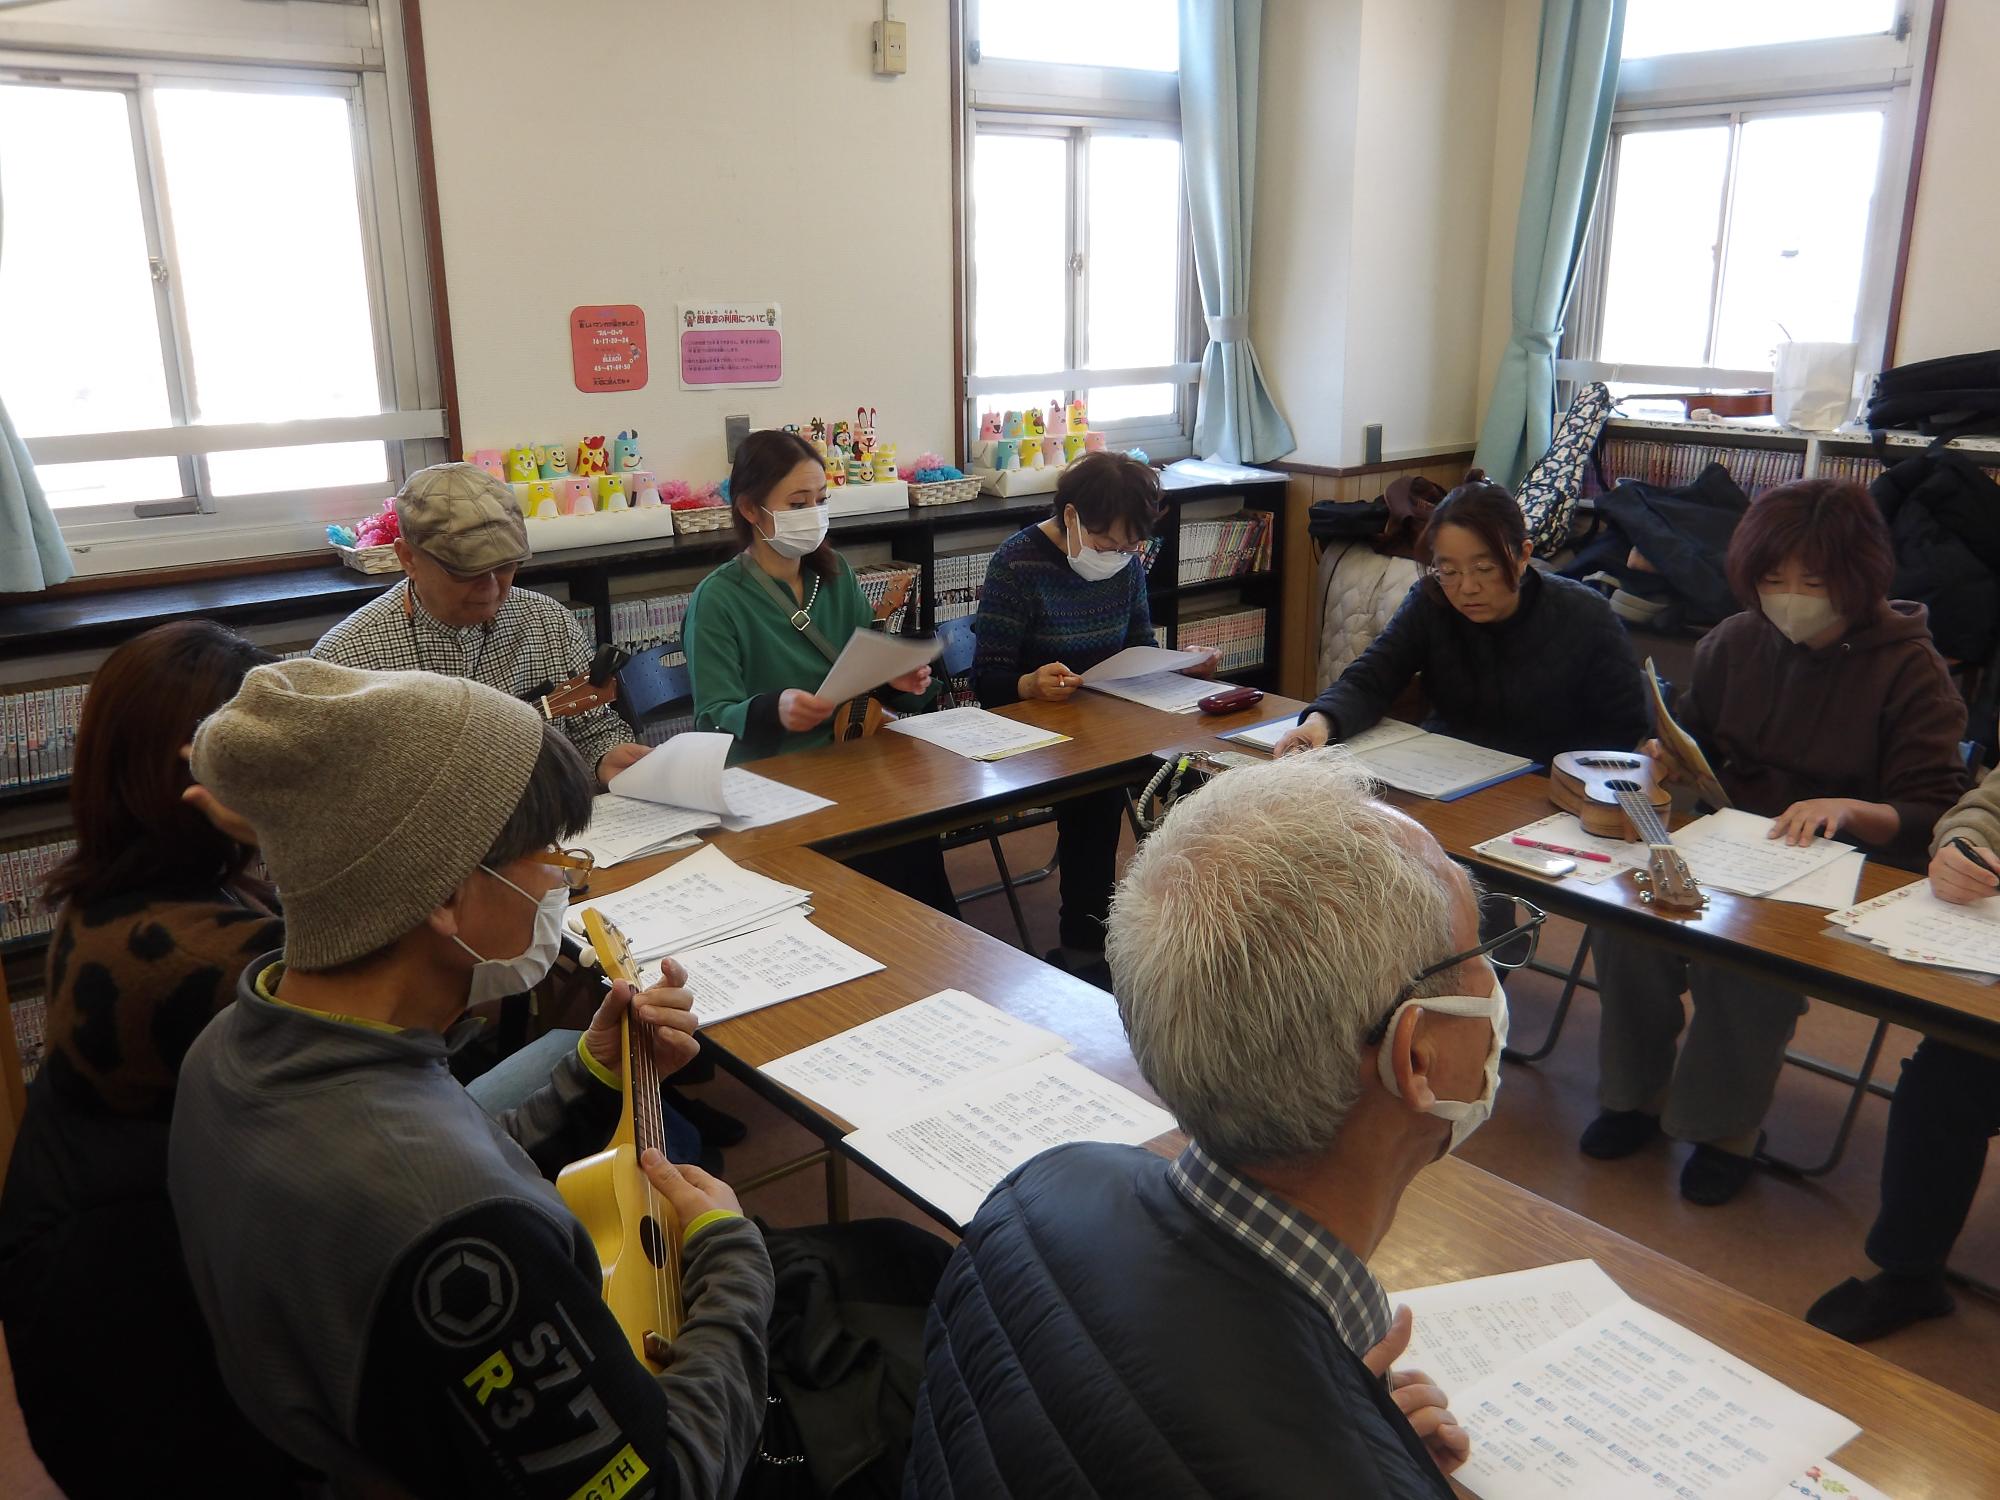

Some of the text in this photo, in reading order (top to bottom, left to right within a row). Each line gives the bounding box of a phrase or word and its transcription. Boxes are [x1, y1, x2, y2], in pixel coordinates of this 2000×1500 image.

[696, 314, 766, 324] 図書室の利用について
[462, 1349, 535, 1430] R3
[512, 1321, 582, 1391] S7
